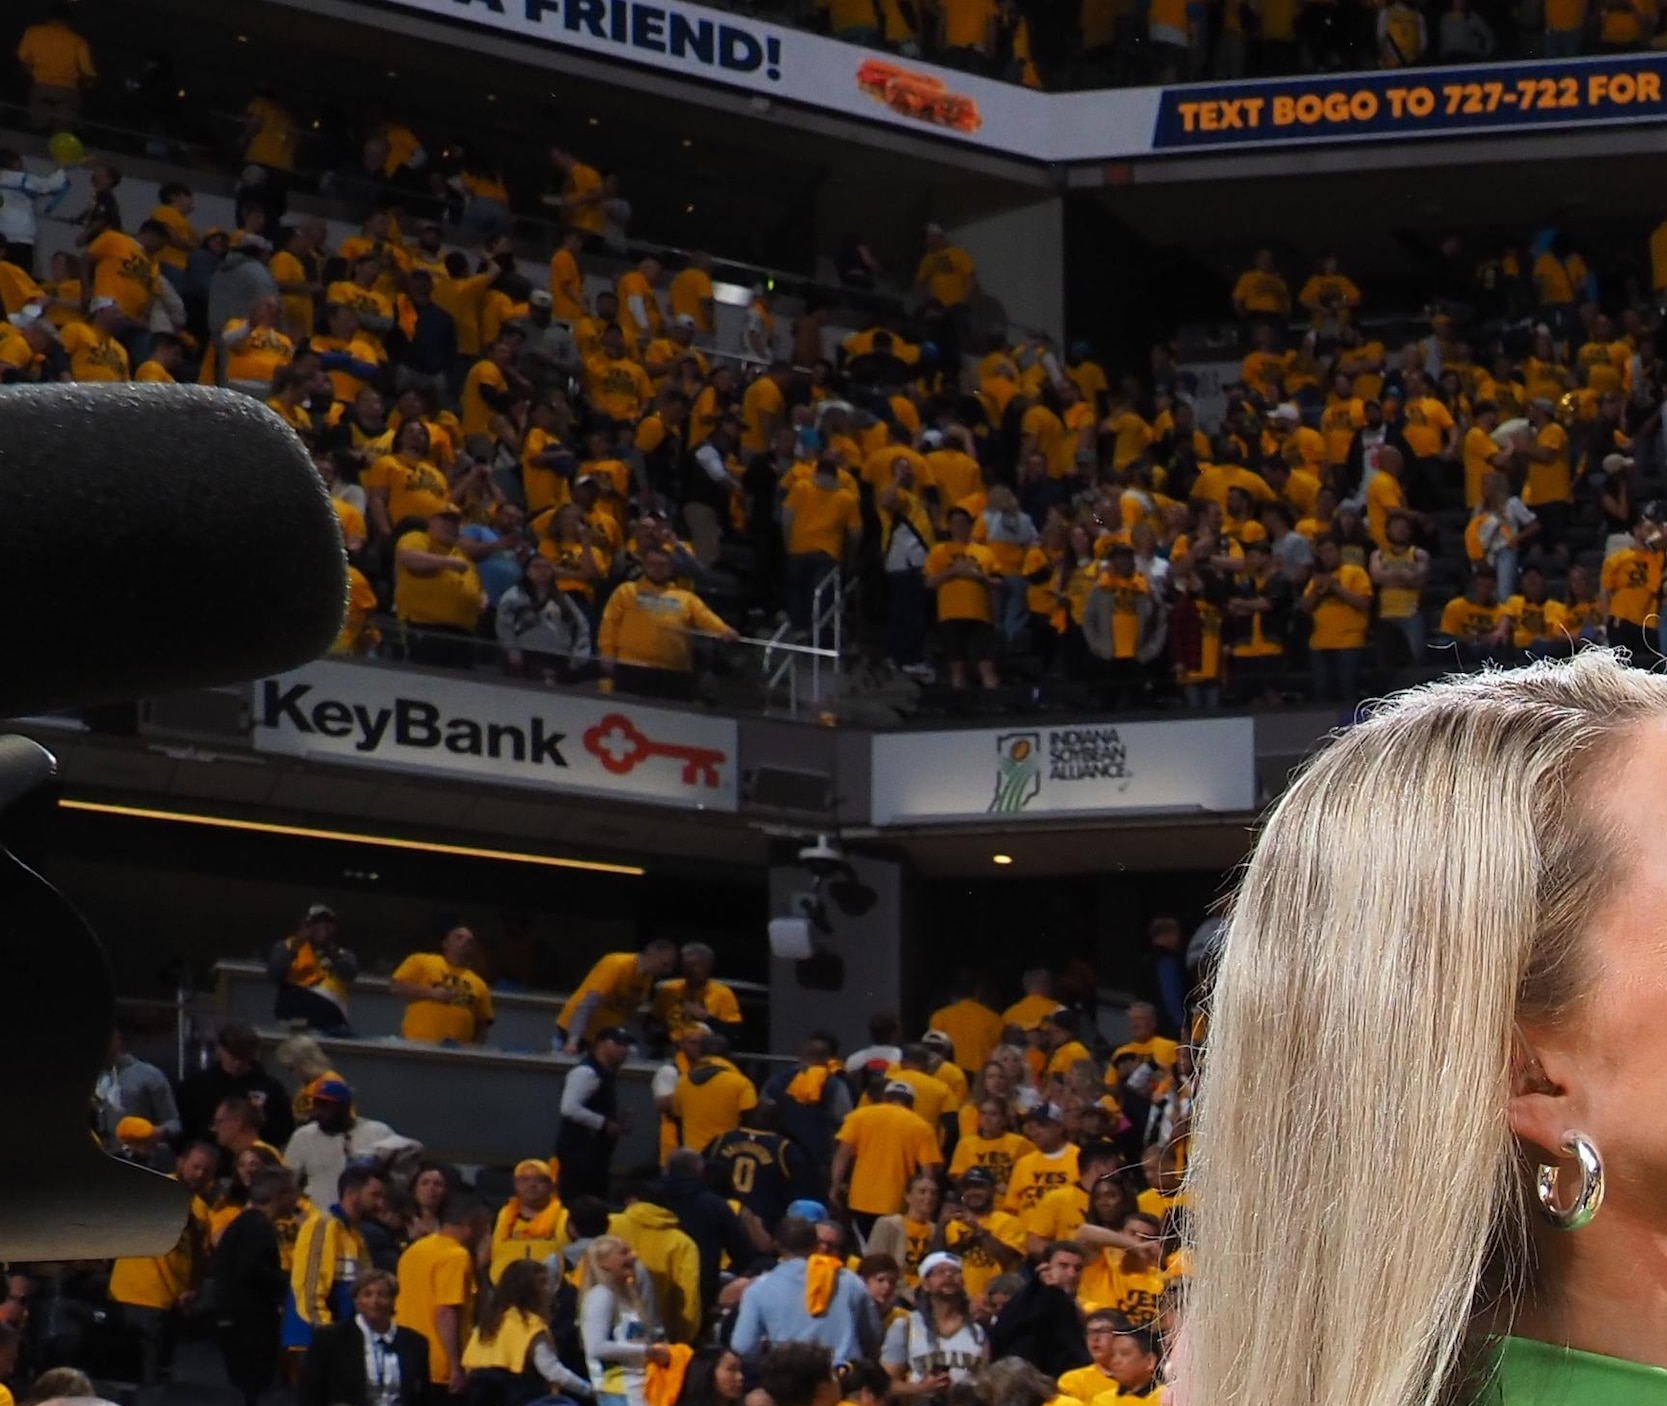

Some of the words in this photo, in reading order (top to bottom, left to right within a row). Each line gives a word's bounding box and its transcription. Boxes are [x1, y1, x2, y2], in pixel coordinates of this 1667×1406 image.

[525, 0, 782, 82] FRIEND!
[1178, 97, 1264, 133] TEXT
[1271, 93, 1377, 126] BOGO
[1386, 87, 1435, 119] TO
[1443, 78, 1580, 115] 727-722
[1588, 74, 1661, 106] FOR
[263, 680, 568, 769] KeyBank
[1049, 728, 1120, 745] INDIANA
[731, 1154, 757, 1195] 0
[976, 1151, 1012, 1163] YES
[1031, 1171, 1067, 1186] YES
